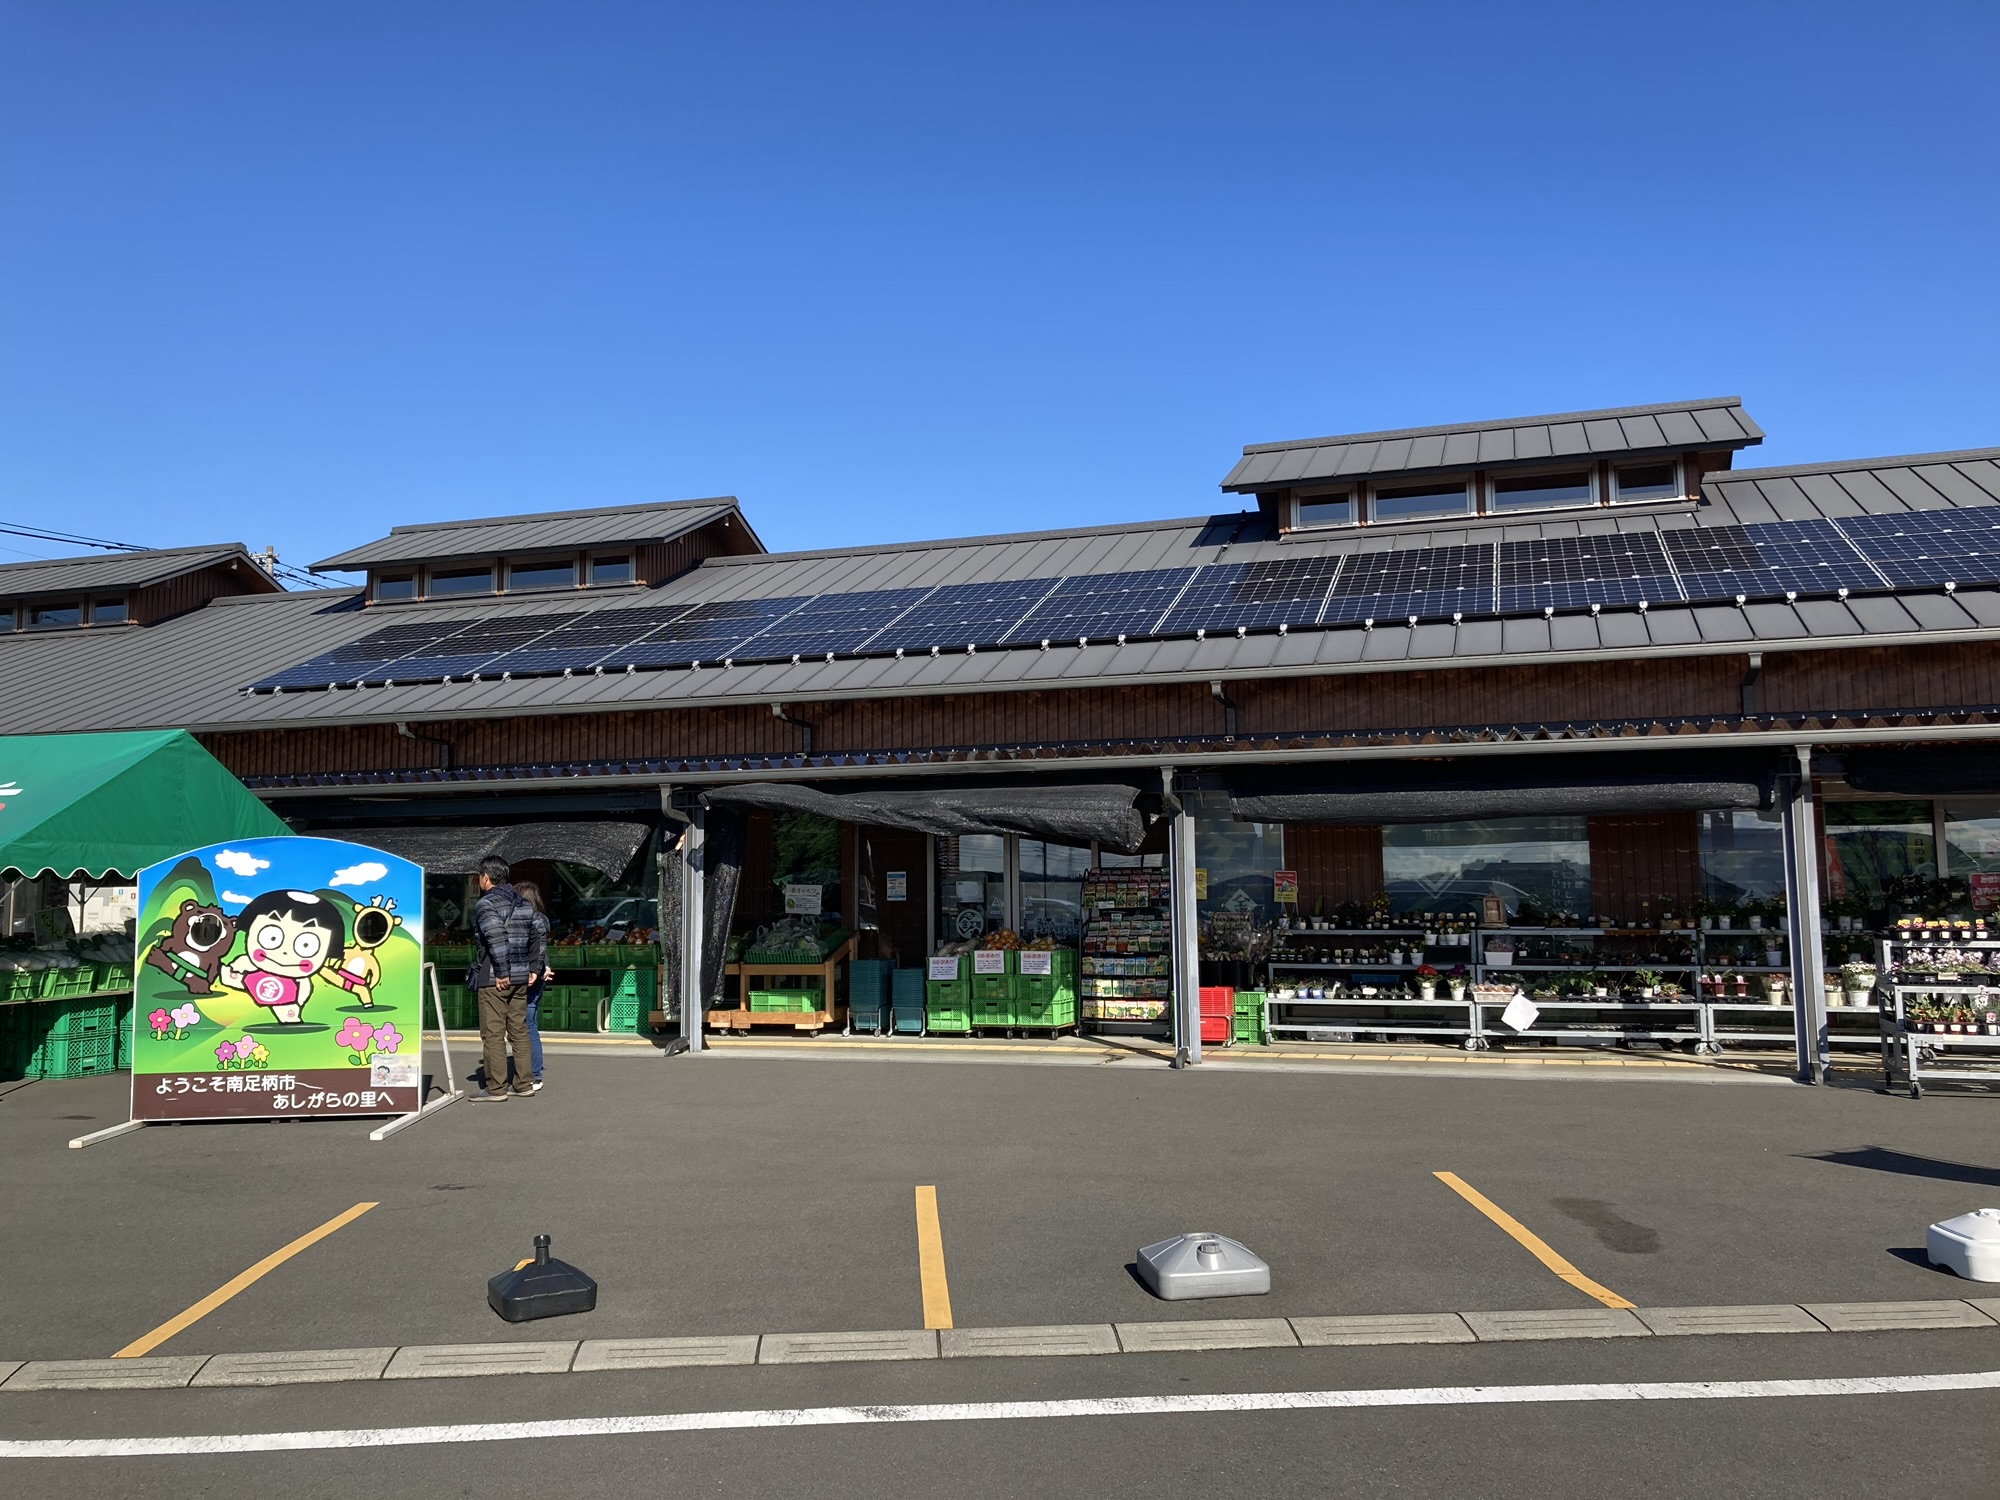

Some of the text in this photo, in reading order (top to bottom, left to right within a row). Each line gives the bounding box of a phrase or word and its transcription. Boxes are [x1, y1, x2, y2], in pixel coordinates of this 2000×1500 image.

[261, 980, 280, 1000] 金
[155, 1074, 296, 1095] ようこそ南足柄市
[272, 1090, 395, 1110] あしがらの里へ
